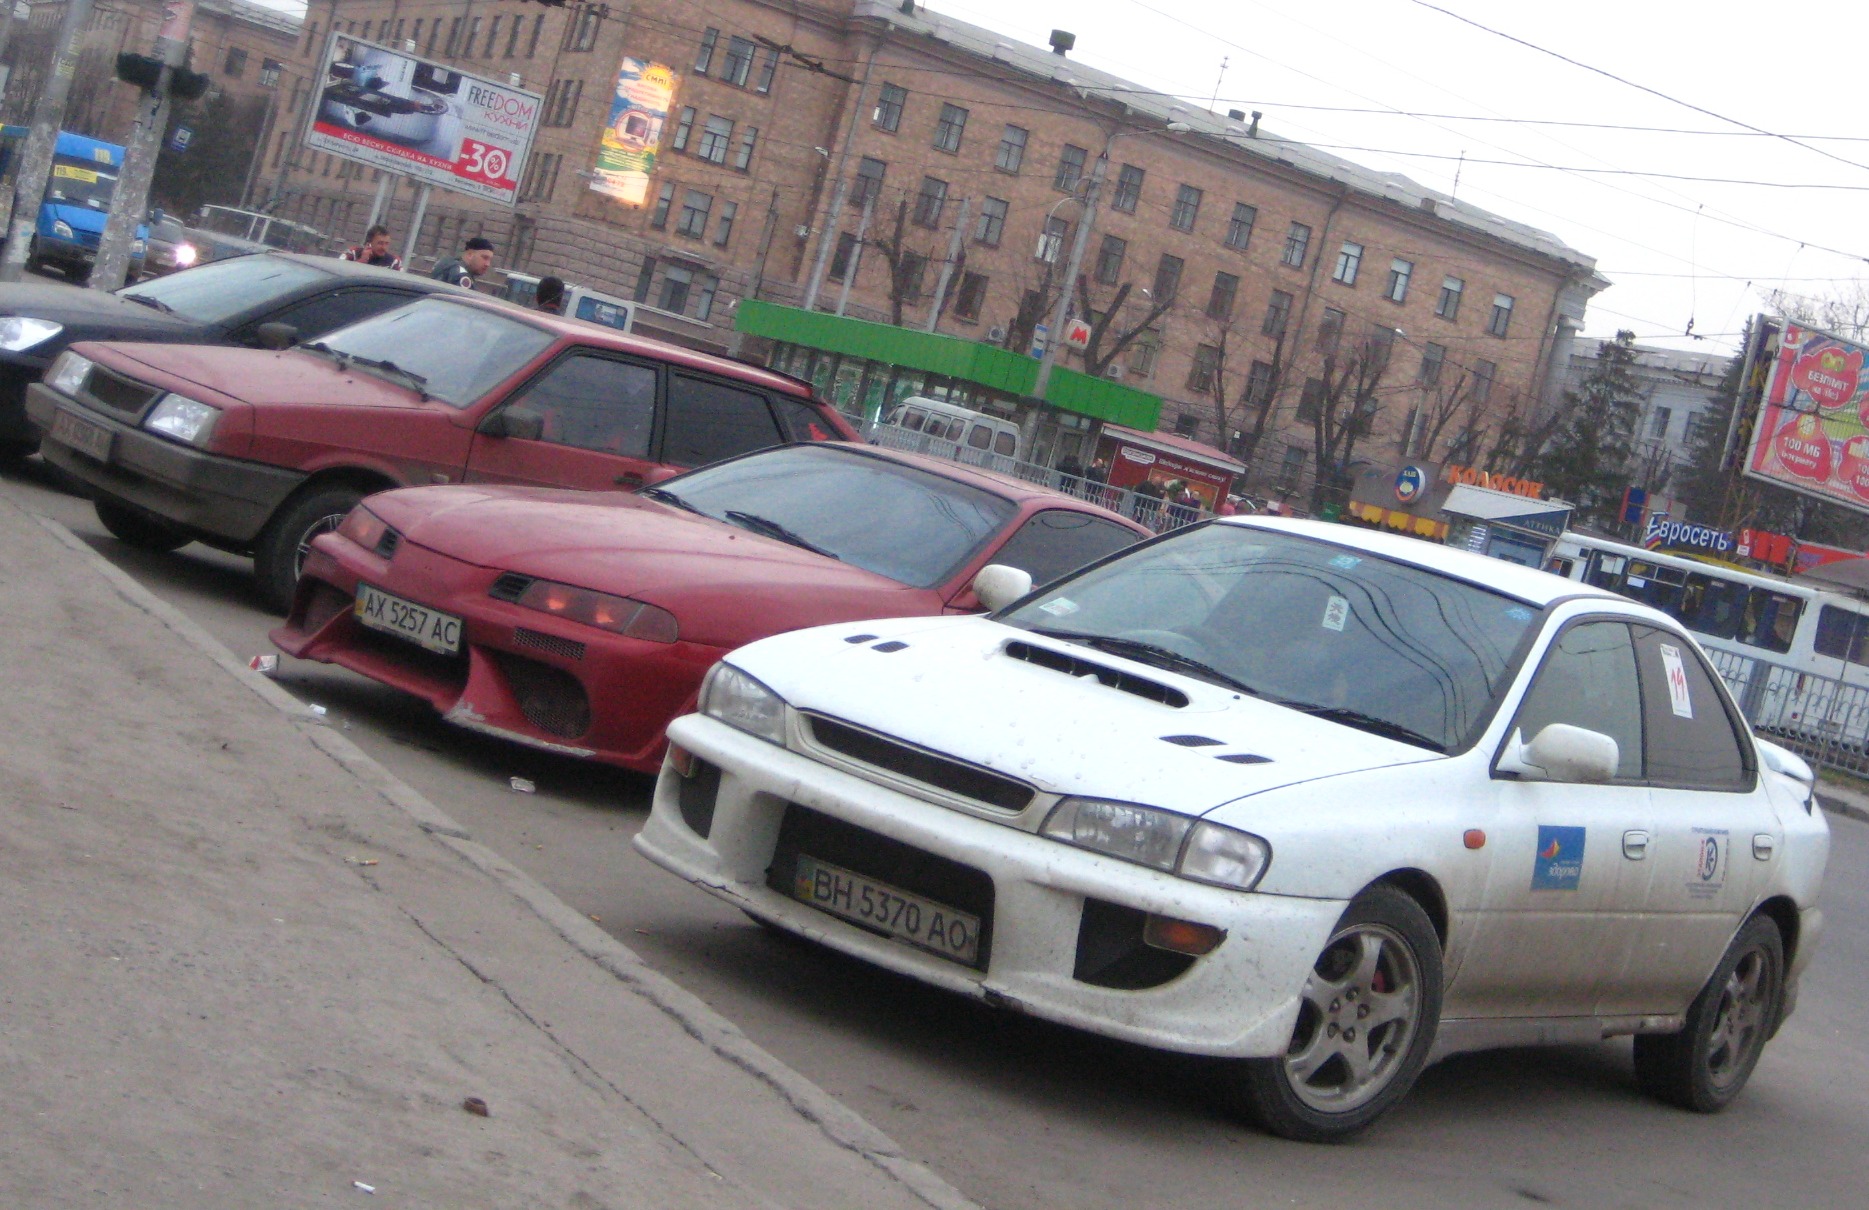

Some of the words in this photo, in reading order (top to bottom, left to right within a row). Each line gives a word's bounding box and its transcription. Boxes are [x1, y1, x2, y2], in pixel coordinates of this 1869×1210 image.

[467, 85, 534, 121] FREEDOM
[483, 111, 529, 131] КУХНИ
[362, 138, 385, 151] ВЕСНУ
[386, 145, 415, 160] СКИДКА
[416, 155, 427, 163] НА
[429, 158, 453, 171] КУХНИ
[1784, 436, 1802, 451] 100
[1803, 443, 1821, 458] МБ
[1448, 464, 1544, 499] КОЛОСОК
[1646, 511, 1729, 550] Евросеть
[365, 592, 387, 620] AX
[390, 601, 428, 634] 5257
[431, 617, 458, 645] AC
[814, 868, 854, 910] BH
[859, 885, 921, 935] 5370
